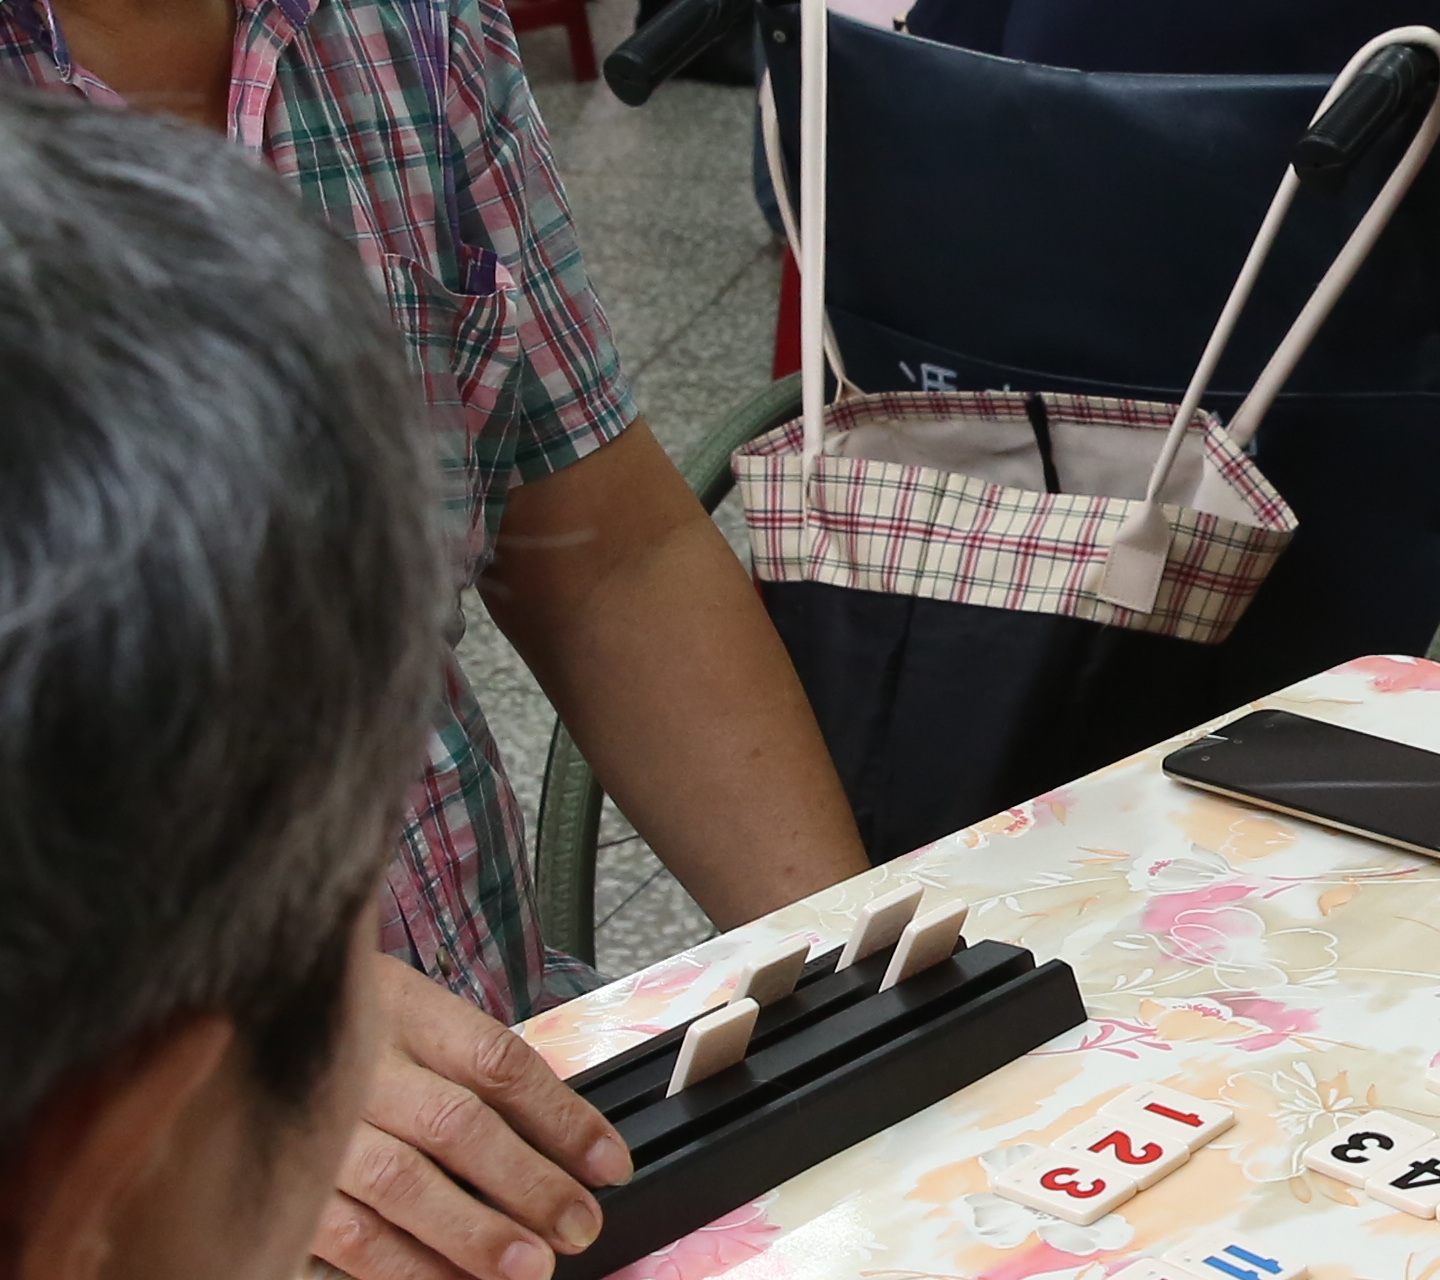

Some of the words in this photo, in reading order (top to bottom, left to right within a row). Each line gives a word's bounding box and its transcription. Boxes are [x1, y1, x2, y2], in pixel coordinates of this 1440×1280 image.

[1042, 1168, 1106, 1198] 3
[1090, 1131, 1163, 1164] 2
[1146, 1103, 1203, 1126] 1
[1331, 1132, 1393, 1163] 3
